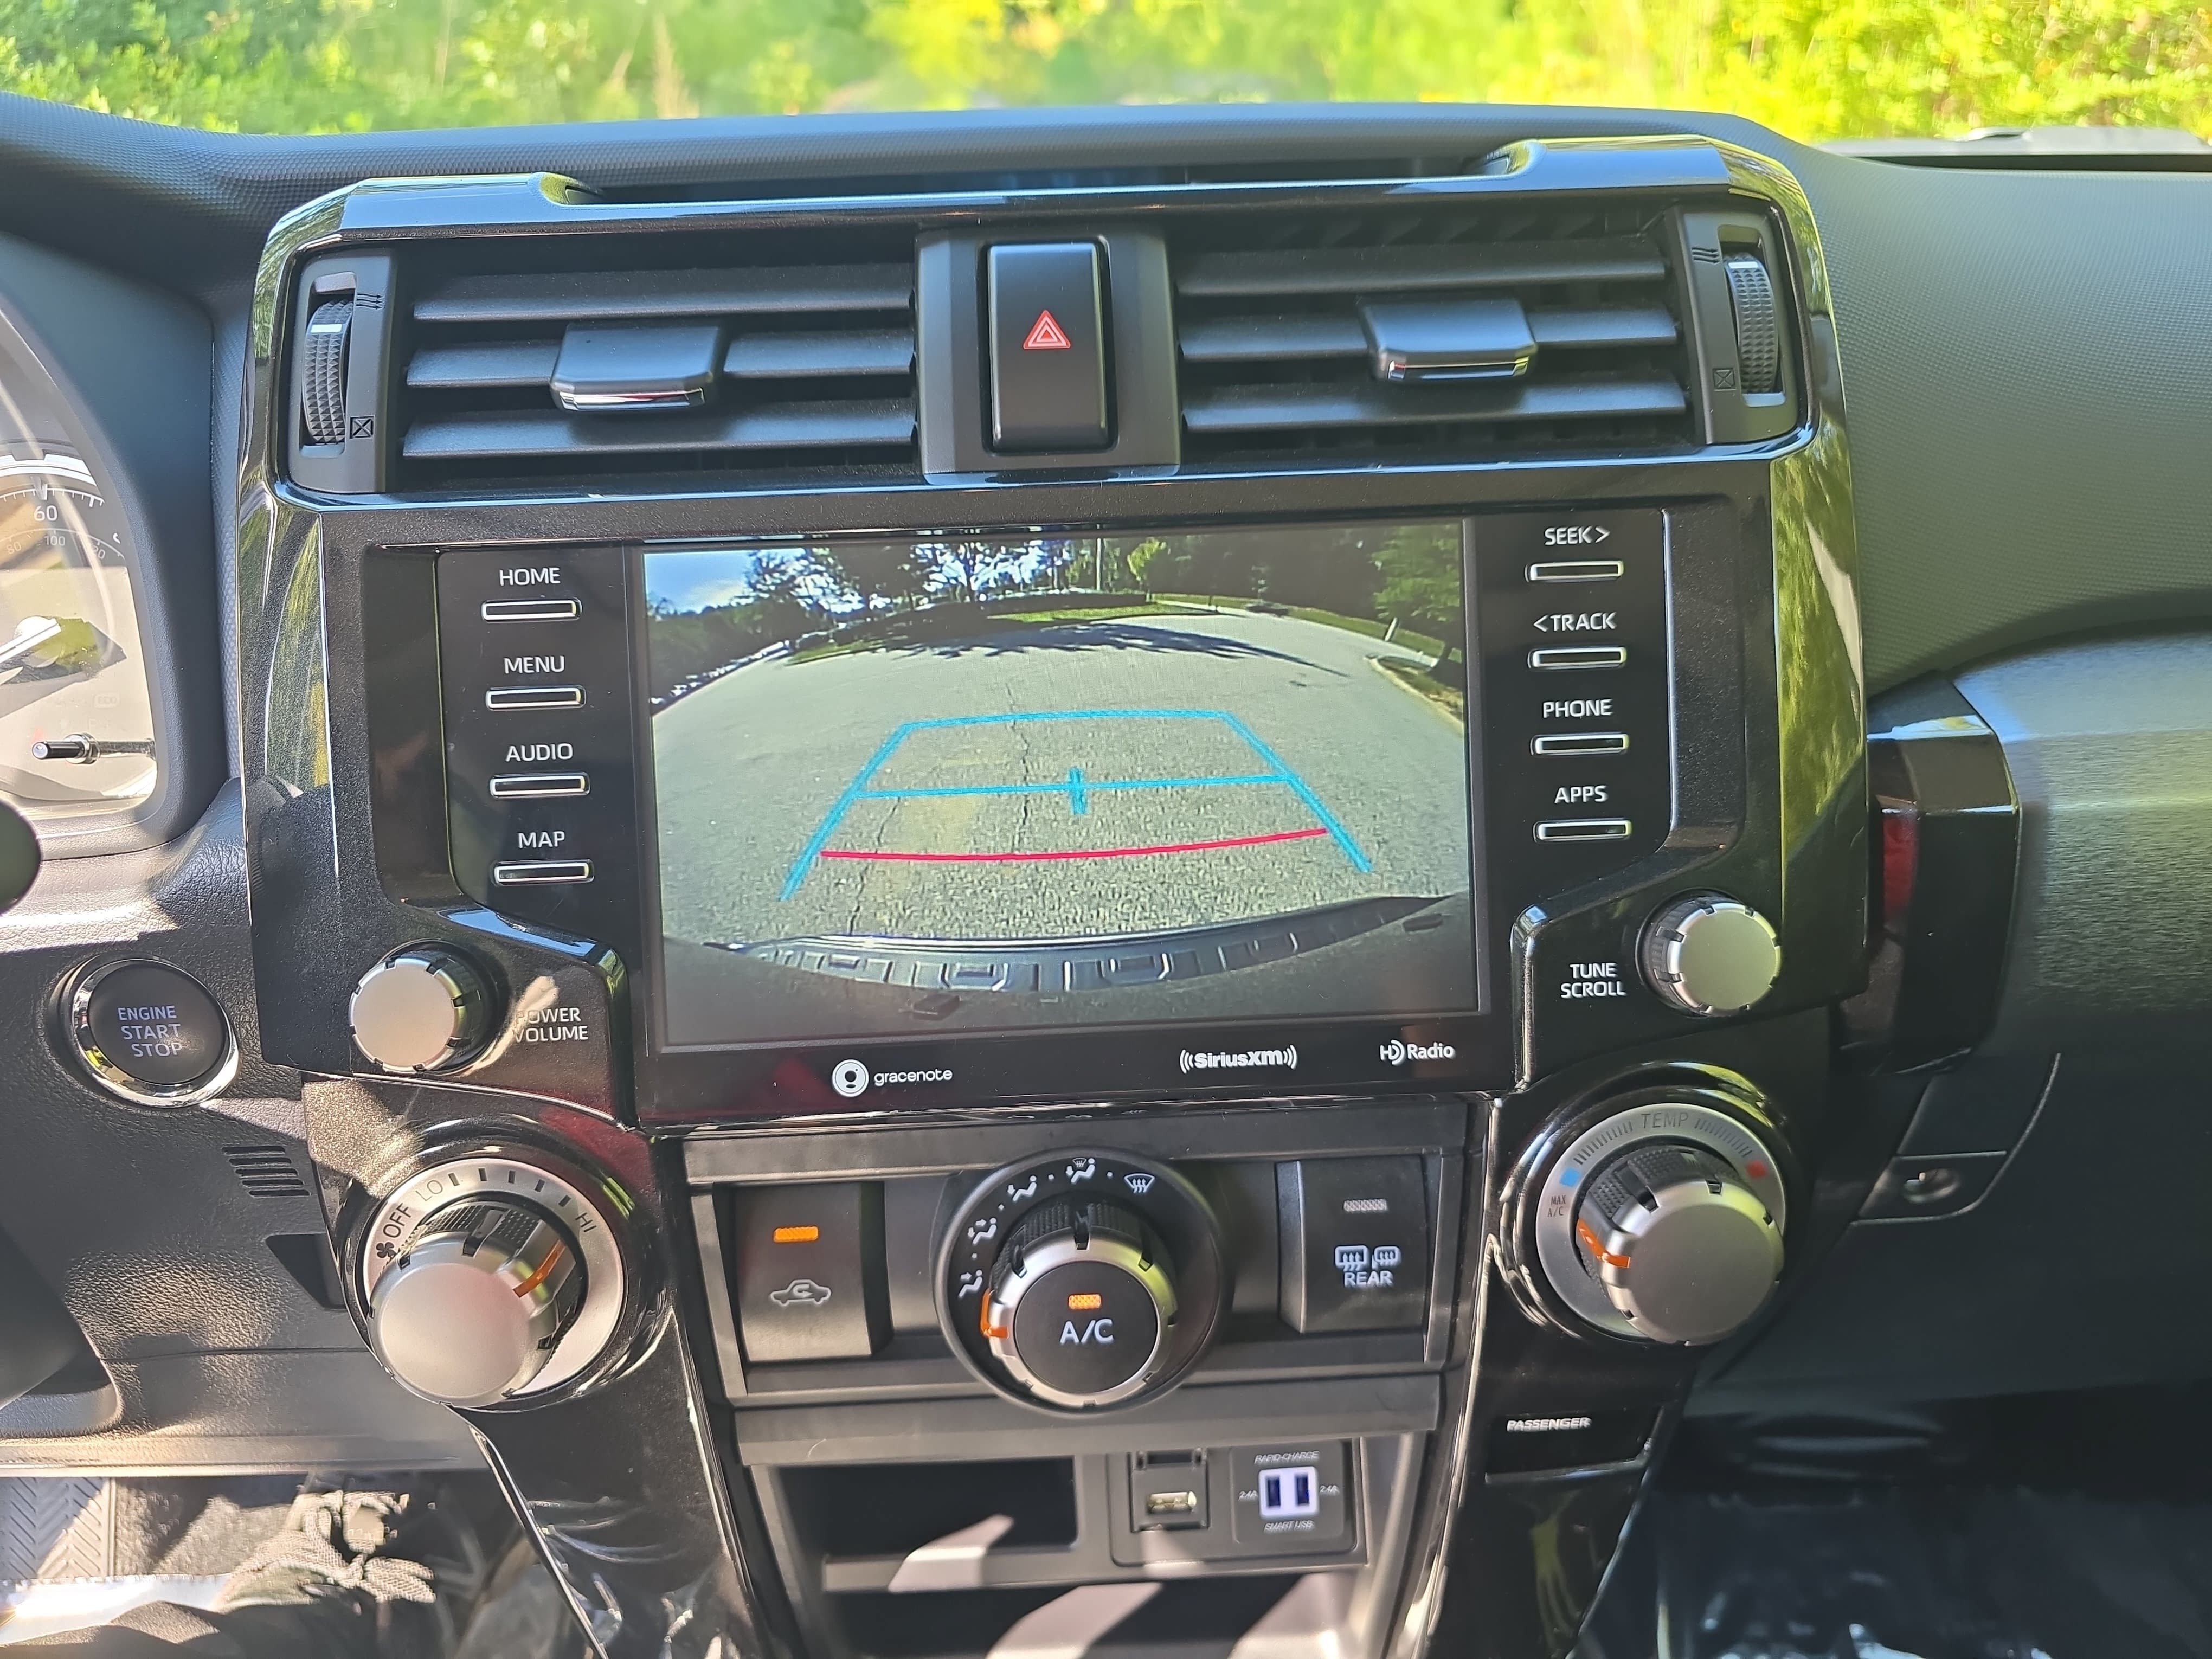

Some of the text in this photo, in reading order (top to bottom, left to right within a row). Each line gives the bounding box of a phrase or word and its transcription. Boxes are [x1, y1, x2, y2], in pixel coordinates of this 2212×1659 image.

[34, 505, 57, 522] 60
[44, 535, 66, 546] 100
[499, 567, 561, 586] HOME
[504, 655, 565, 674] MENU
[1542, 699, 1612, 718] PHONE
[505, 743, 573, 762] AUDIO
[1554, 785, 1608, 803] APPS
[518, 831, 565, 848] MAP
[1570, 962, 1618, 979] TUNE
[1560, 981, 1627, 999] SCROLL
[118, 1005, 177, 1021] ENGINE
[516, 1007, 581, 1024] POWER
[121, 1023, 181, 1040] START
[513, 1025, 589, 1043] VOLUME
[131, 1043, 182, 1057] STOP
[1380, 1040, 1455, 1064] HD Radio
[873, 1069, 953, 1086] gracenote
[1641, 1111, 1689, 1129] TEMP
[415, 1179, 443, 1202] LO
[1551, 1194, 1566, 1206] MAX
[383, 1202, 412, 1239] OFF
[1547, 1206, 1564, 1218] A/C
[575, 1211, 597, 1233] HI
[1344, 1270, 1393, 1287] REAR
[1060, 1319, 1114, 1345] A/C
[1507, 1417, 1591, 1431] PASSENGER
[1264, 1520, 1315, 1533] SMART USB
